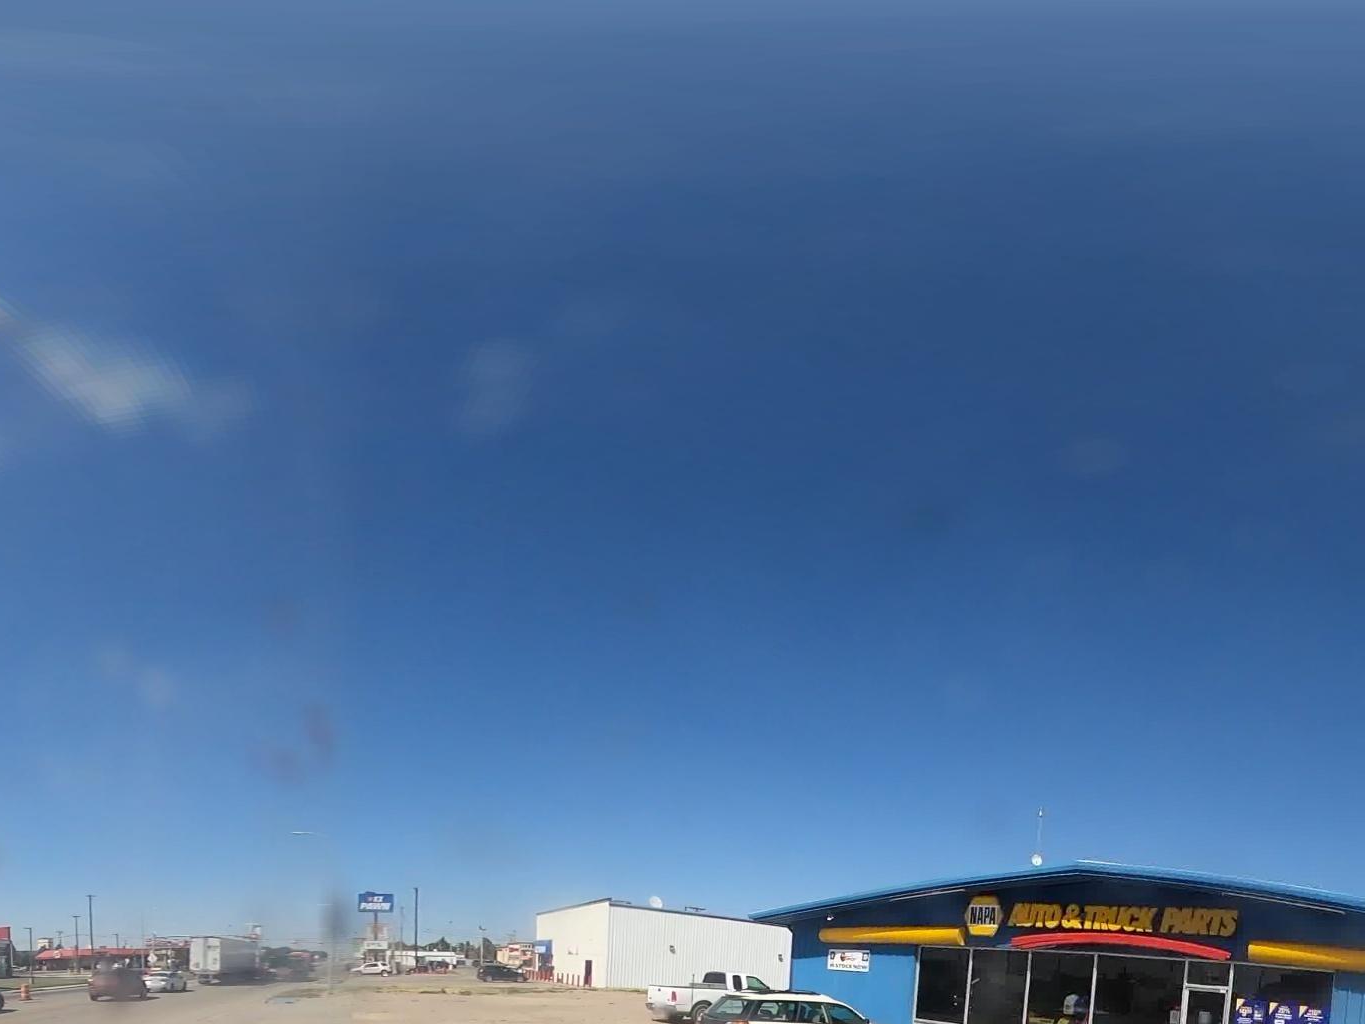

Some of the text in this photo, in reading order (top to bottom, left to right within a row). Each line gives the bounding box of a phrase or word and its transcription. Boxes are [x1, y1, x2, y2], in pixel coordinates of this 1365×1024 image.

[969, 906, 997, 925] NAPA
[1008, 903, 1238, 937] AUTO & TRUCK PARTS
